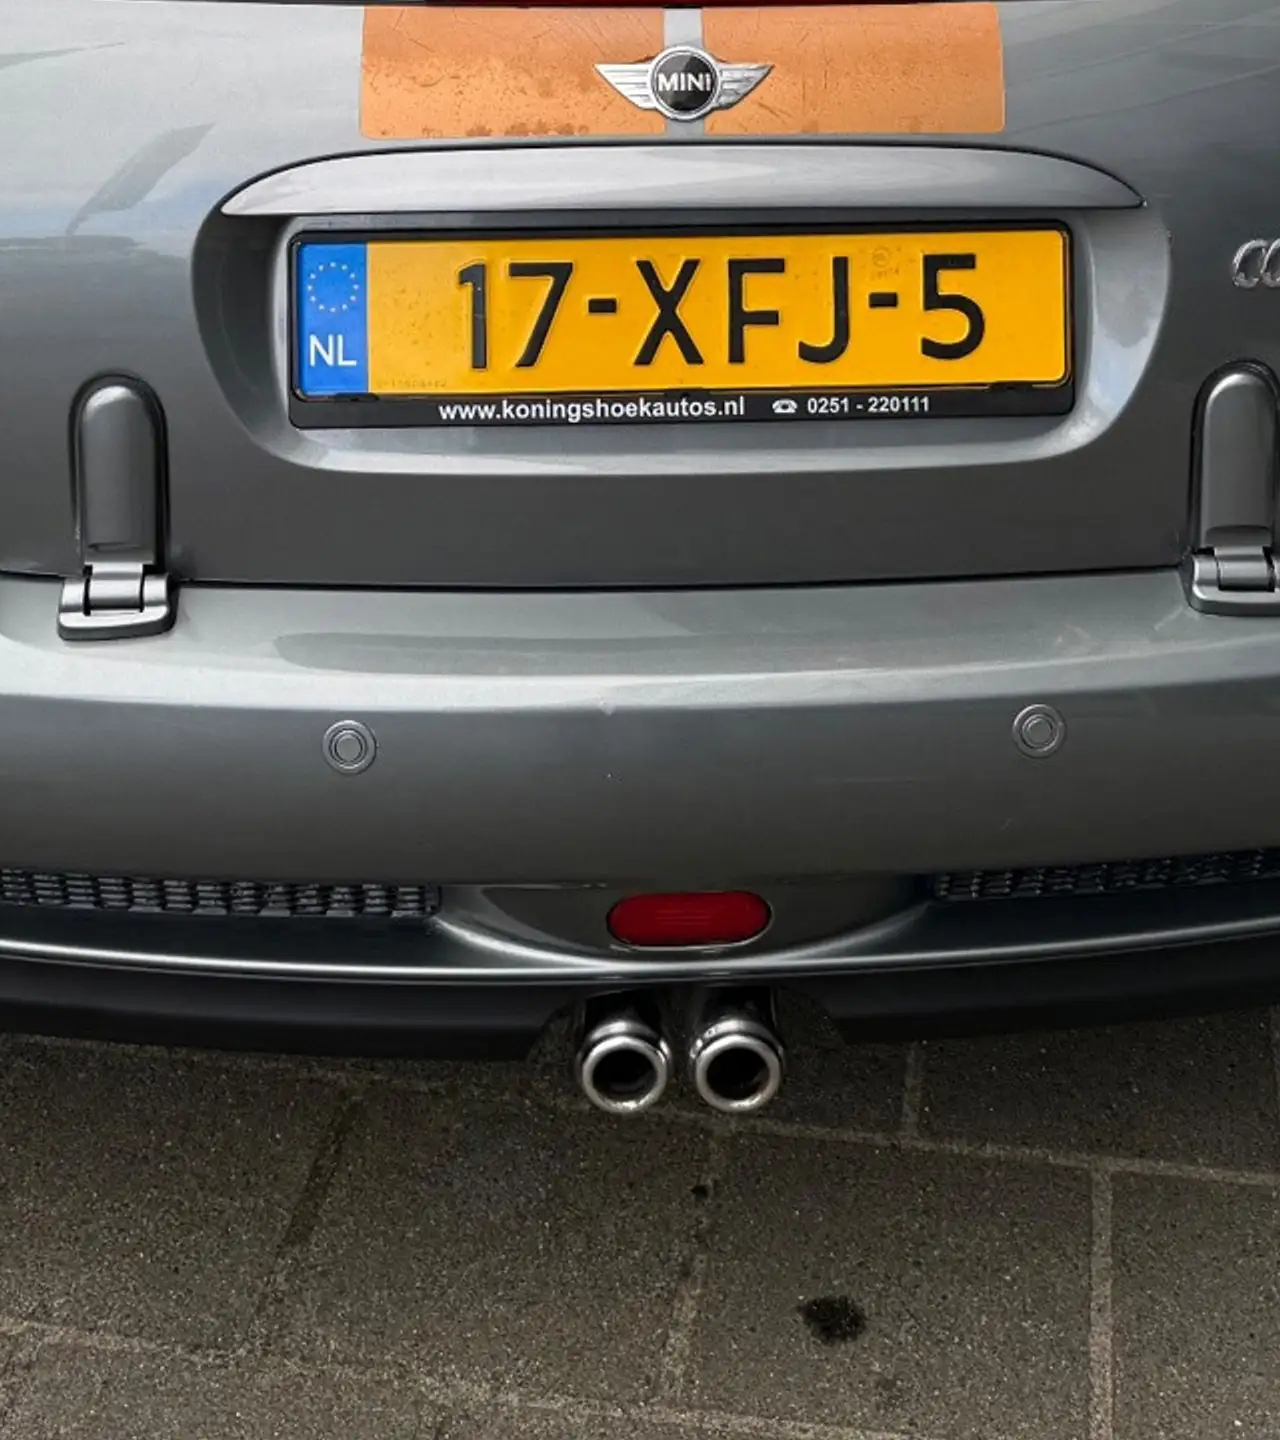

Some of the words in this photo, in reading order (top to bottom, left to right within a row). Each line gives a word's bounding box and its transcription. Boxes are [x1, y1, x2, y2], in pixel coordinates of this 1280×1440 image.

[657, 72, 712, 93] MINI
[456, 251, 986, 370] 17-XFJ-5
[309, 334, 358, 368] NL
[439, 395, 745, 423] www.koningshoekautos.nl
[807, 397, 850, 415] 0251
[868, 396, 931, 414] 220111
